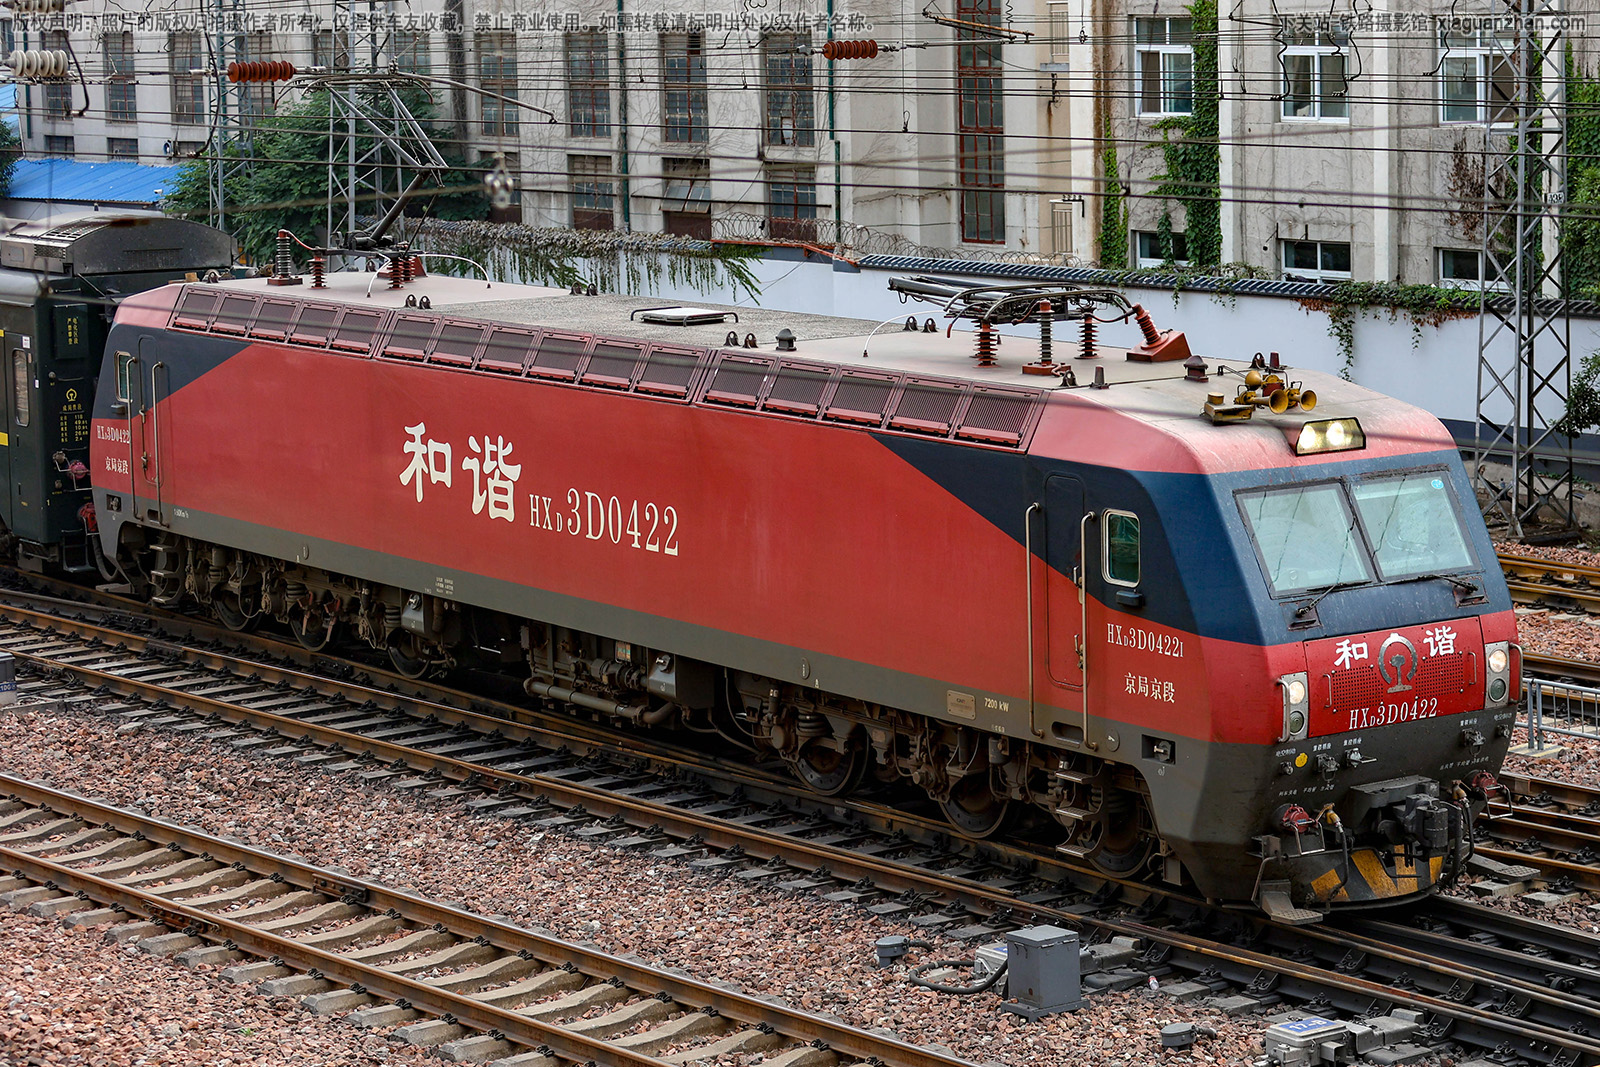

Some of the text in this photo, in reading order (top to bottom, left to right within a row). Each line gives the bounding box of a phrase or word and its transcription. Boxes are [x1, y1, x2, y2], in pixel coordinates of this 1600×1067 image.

[399, 421, 522, 522] 和谐
[528, 487, 680, 556] HXD3D0422
[1333, 625, 1458, 670] 和 谐
[1124, 672, 1176, 704] 京局京段
[1348, 697, 1439, 730] HXD3D0422
